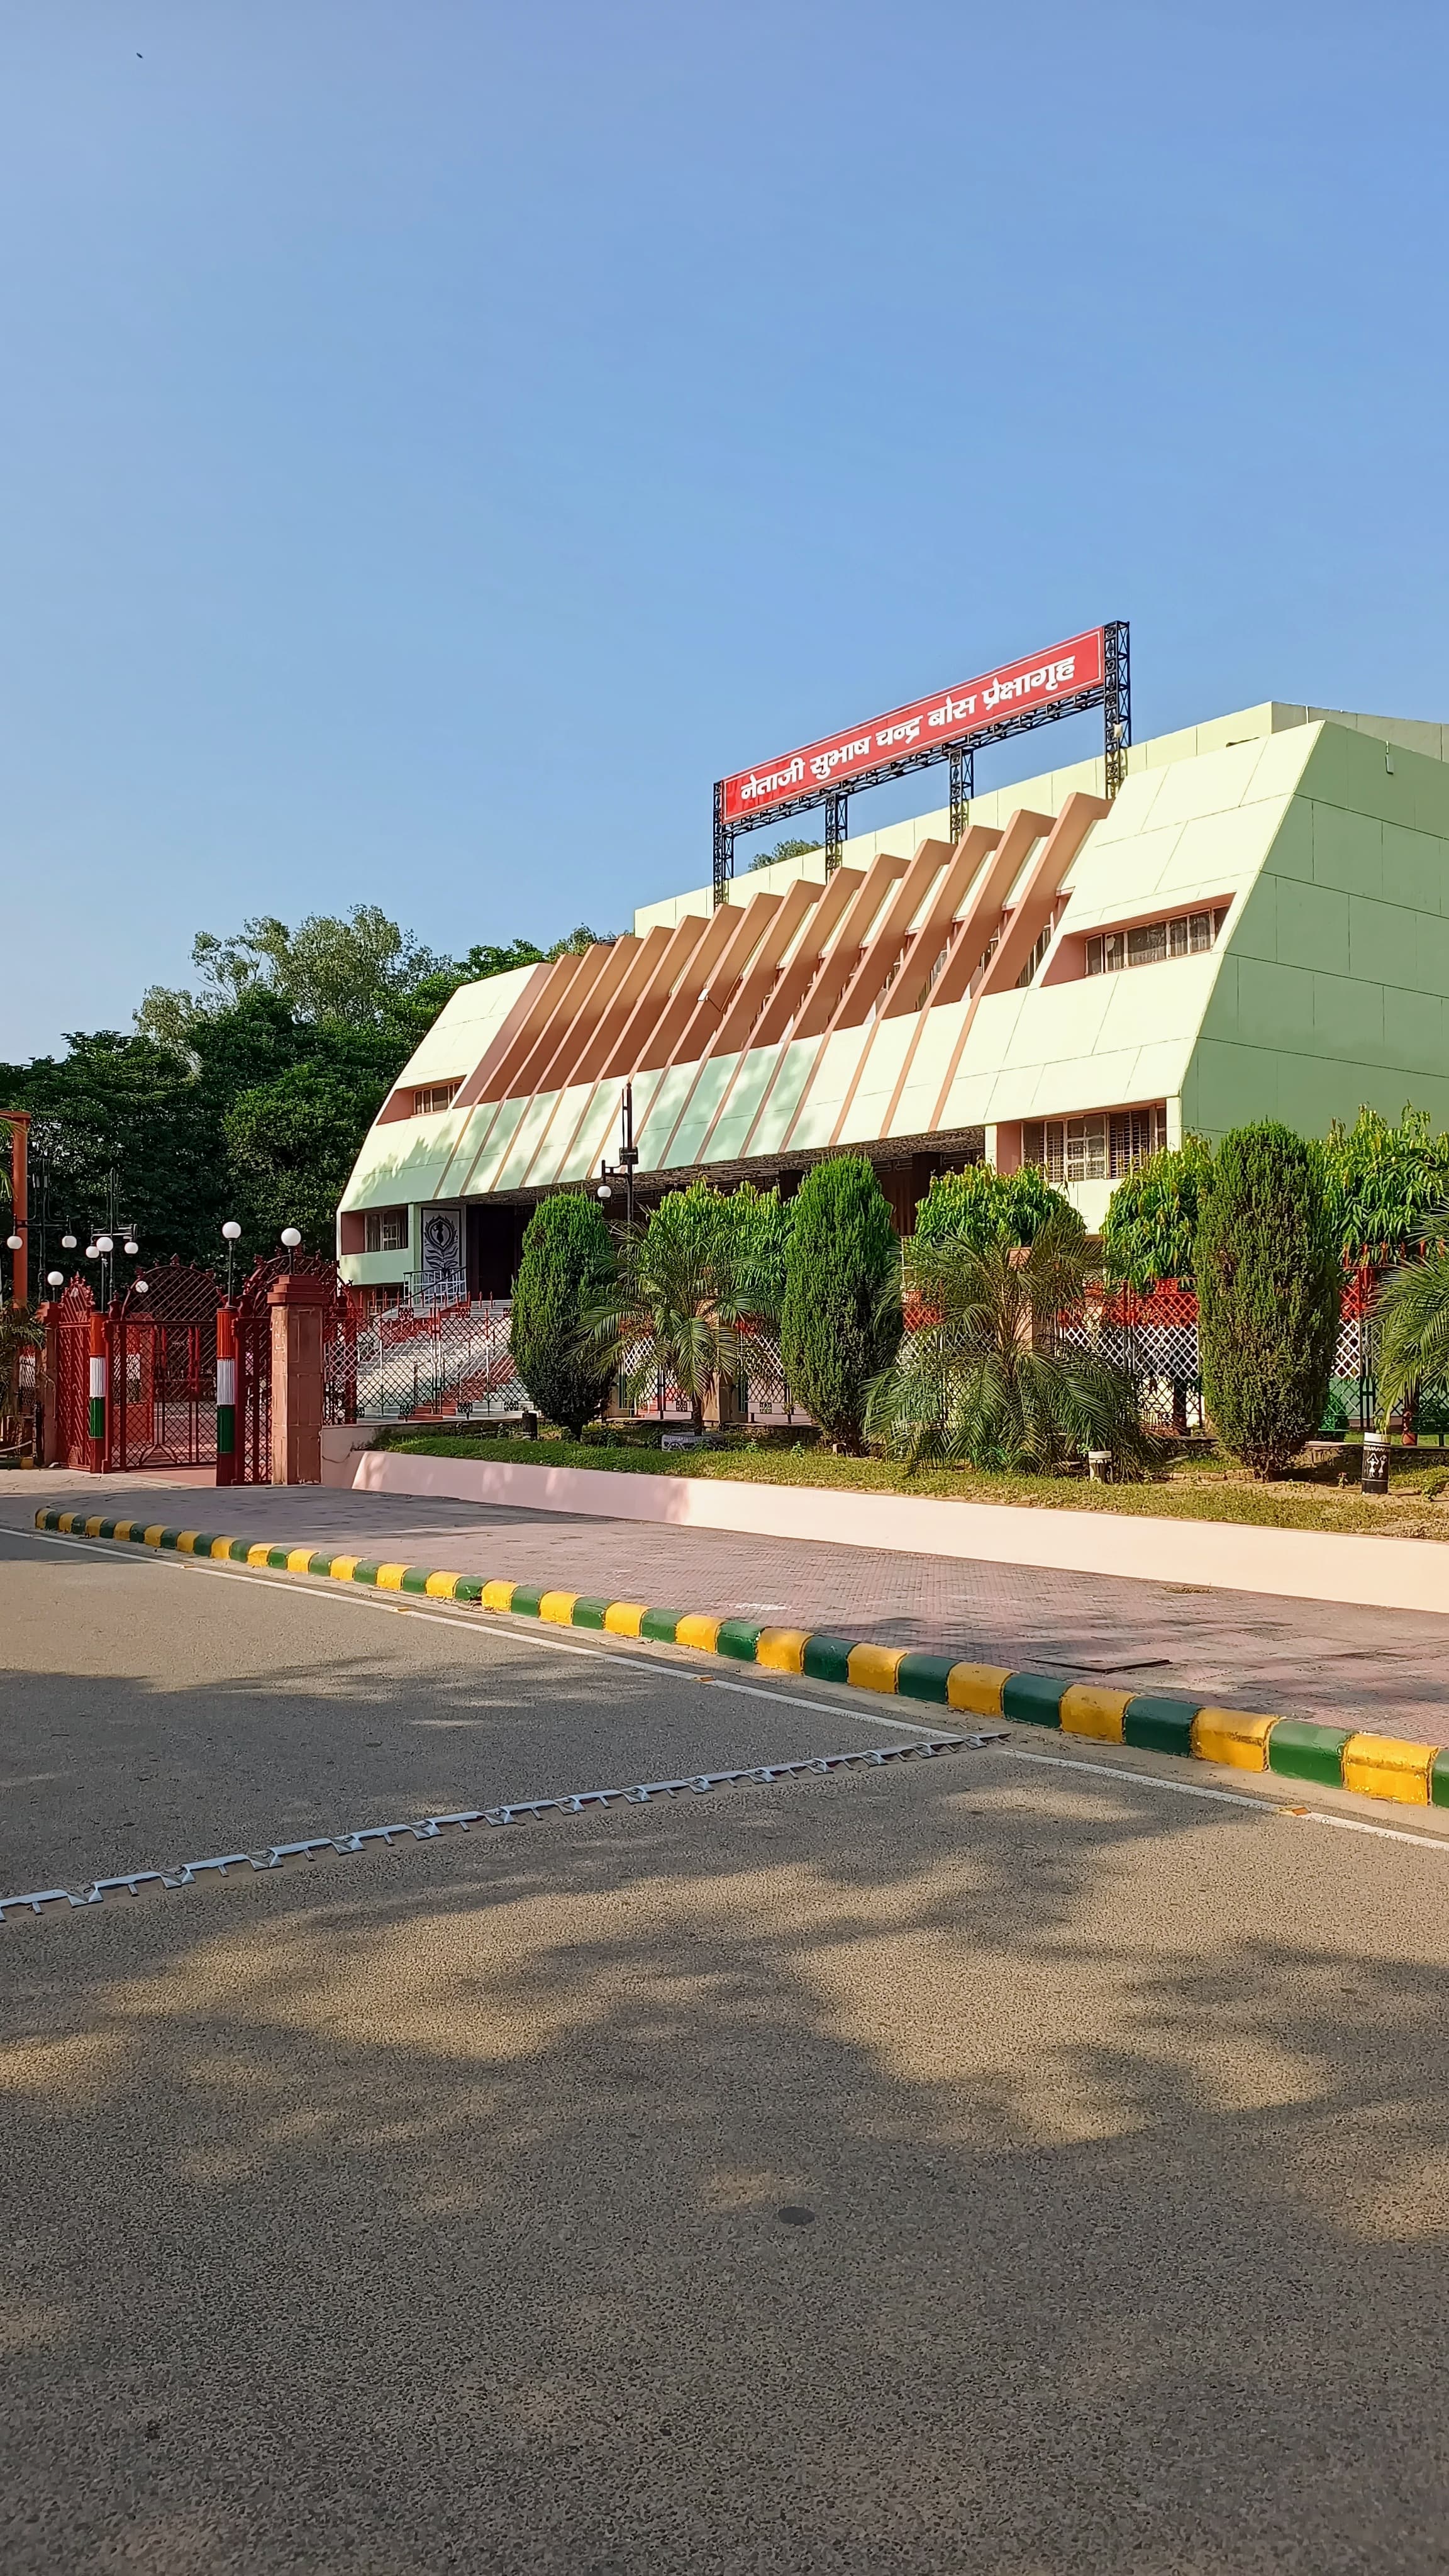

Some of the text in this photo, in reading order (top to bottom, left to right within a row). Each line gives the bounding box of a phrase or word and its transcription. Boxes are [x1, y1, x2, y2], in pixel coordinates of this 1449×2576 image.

[741, 655, 1075, 799] नेताजी सुभाष चन्द्र बोस प्रेक्षागृह
